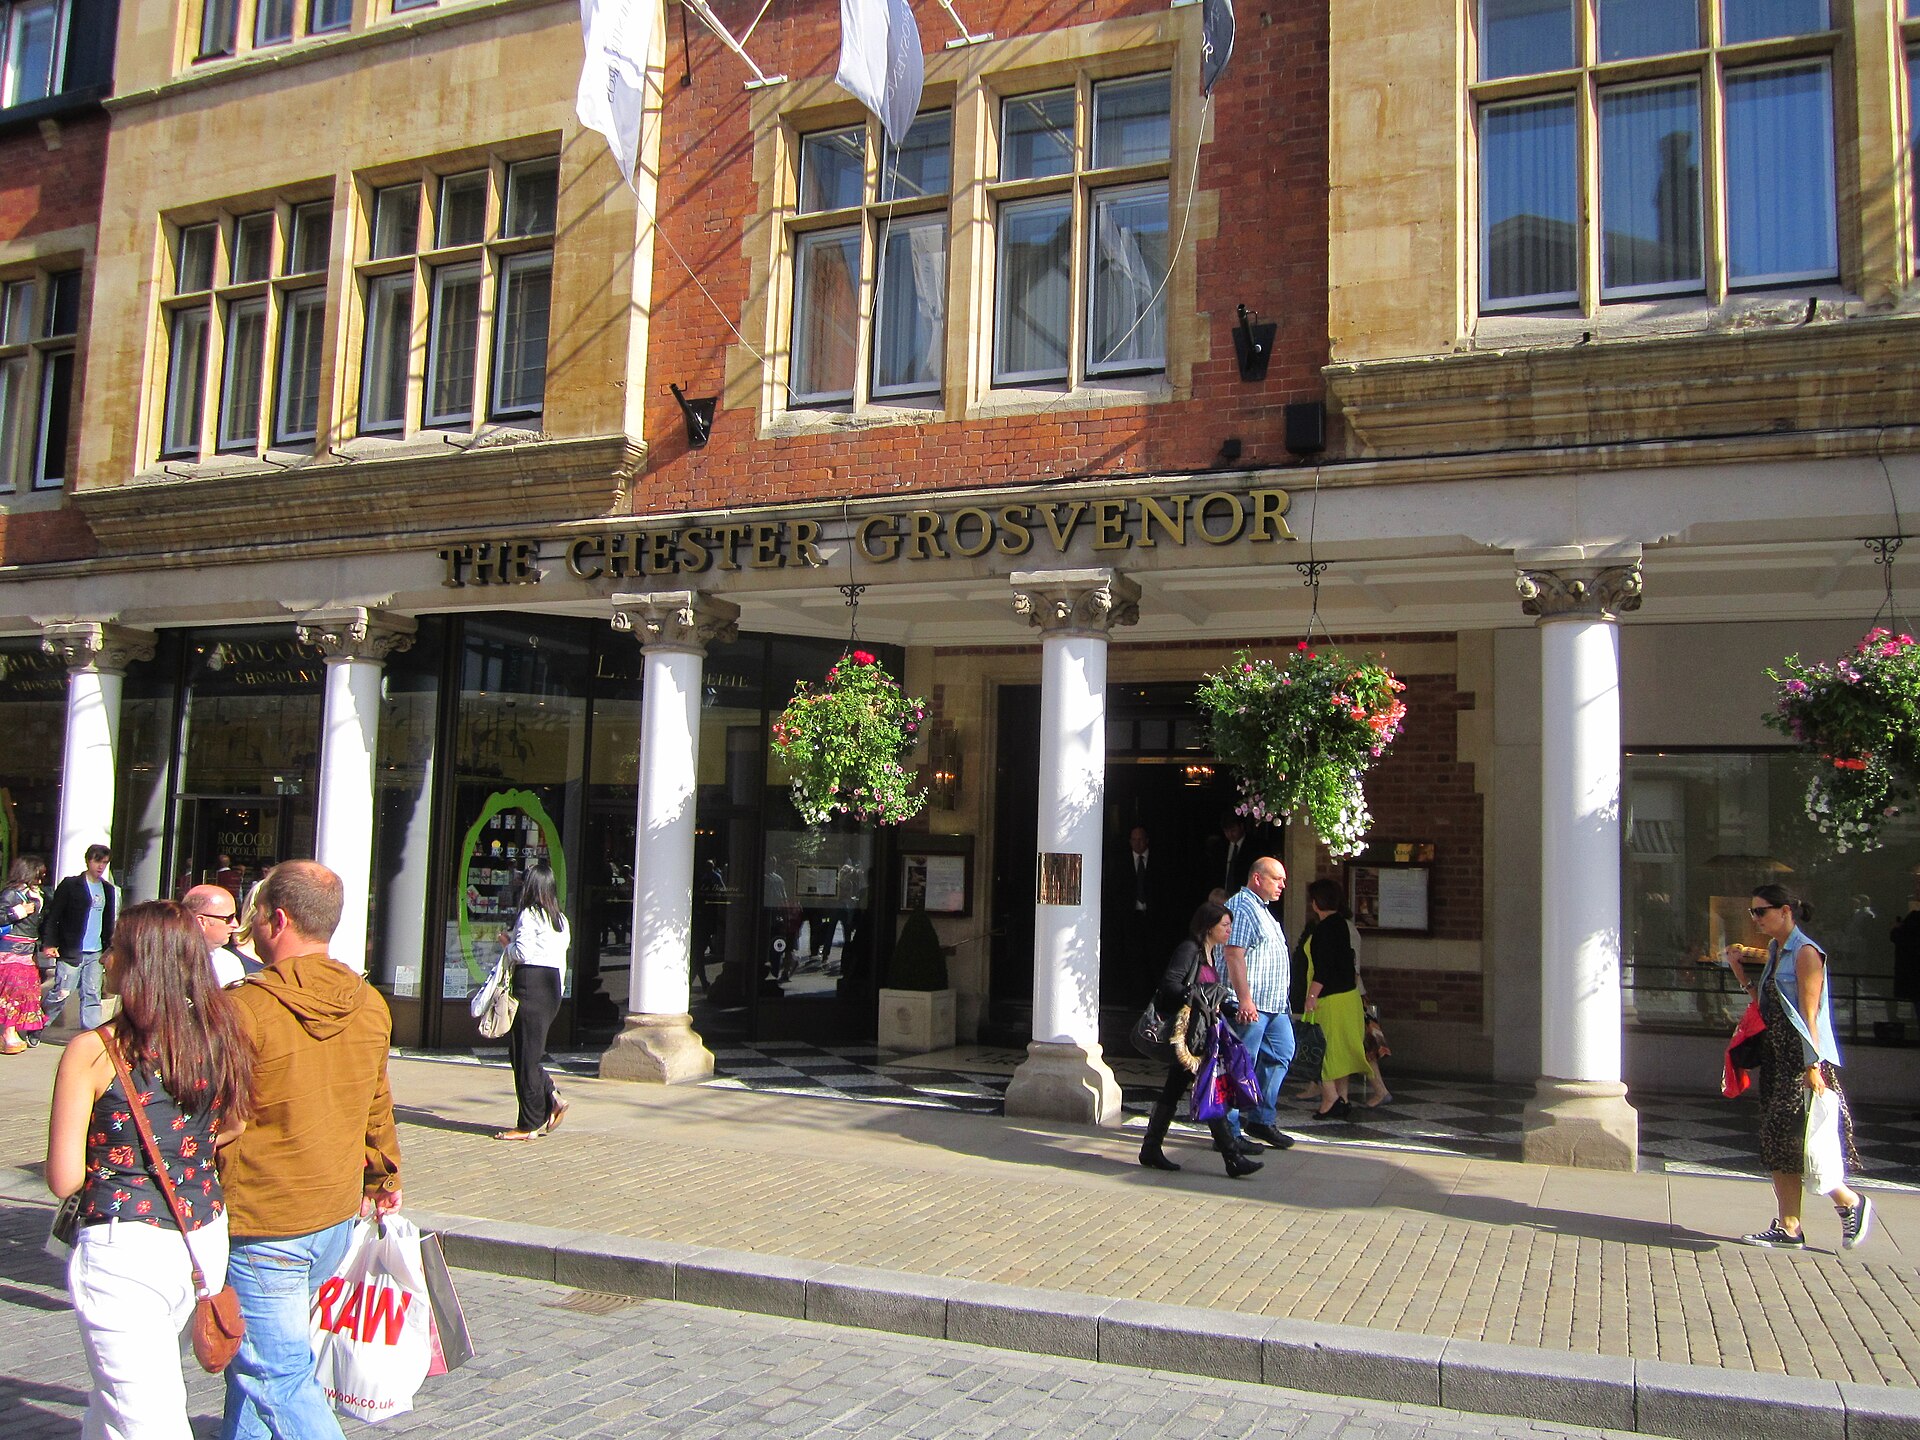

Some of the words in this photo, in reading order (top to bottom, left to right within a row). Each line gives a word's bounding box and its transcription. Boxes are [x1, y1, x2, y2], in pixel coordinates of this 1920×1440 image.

[437, 541, 541, 587] THE
[565, 519, 828, 579] CHESTER
[855, 489, 1298, 562] GROSVENOR
[220, 640, 318, 663] ROCOC
[217, 832, 273, 846] ROCOCO
